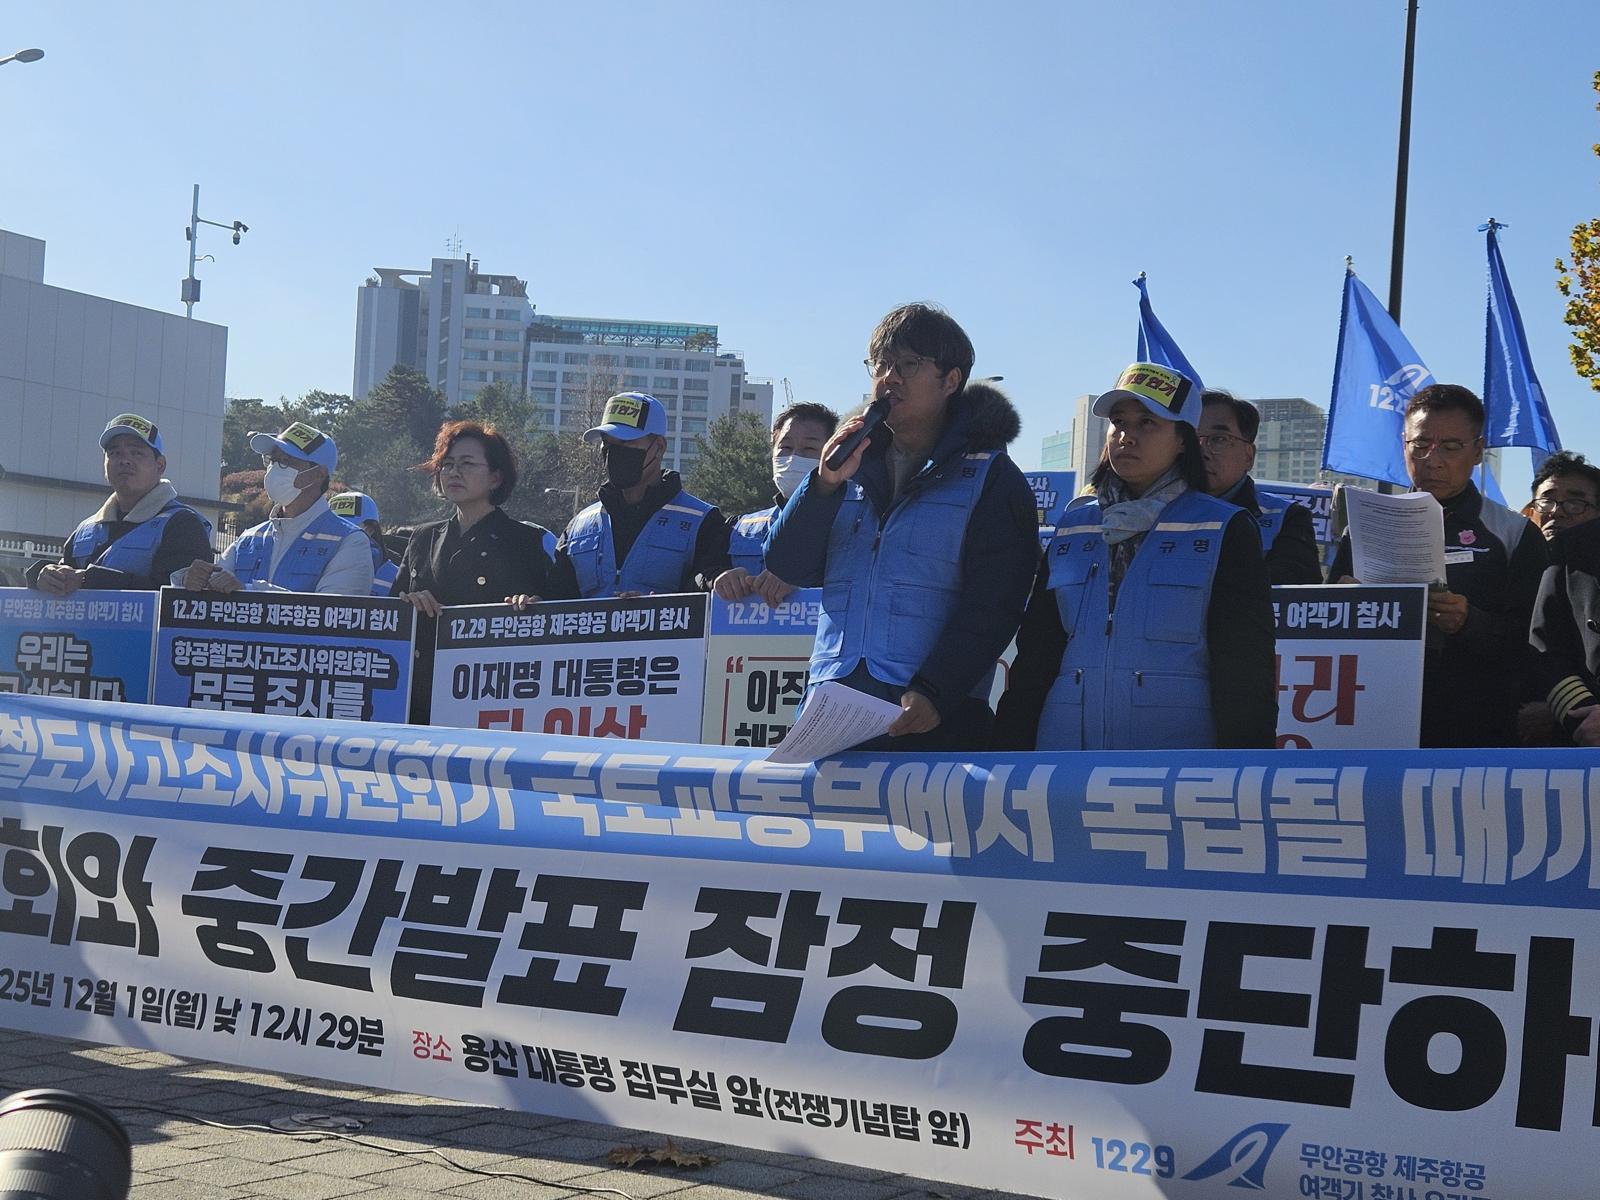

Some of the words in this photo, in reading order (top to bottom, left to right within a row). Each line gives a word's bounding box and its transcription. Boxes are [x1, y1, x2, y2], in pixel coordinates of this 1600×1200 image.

[4, 598, 43, 619] 무안공항
[45, 599, 86, 621] 제주항공
[88, 600, 119, 622] 여객기
[121, 600, 144, 623] 참사
[173, 599, 207, 620] 12.29
[210, 601, 263, 625] 무안공항
[266, 604, 321, 628] 제주항공
[324, 606, 367, 630] 여객기
[370, 609, 399, 632] 참사
[450, 618, 486, 640] 12.29
[489, 614, 546, 639] 무안공항
[549, 611, 607, 636] 제주항공
[610, 608, 655, 633] 여객기
[659, 607, 691, 631] 참사
[726, 602, 769, 625] 12.29
[1286, 601, 1350, 629] 여객기
[1356, 601, 1401, 629] 참사
[17, 635, 89, 674] 우리는
[174, 640, 391, 679] 항공철도사고조사위원회는
[190, 671, 255, 713] 모든
[263, 676, 365, 721] 조사를
[452, 660, 542, 700] 이재명
[551, 655, 681, 698] 대통령은
[0, 712, 517, 831] 철도사고조사위원회가
[530, 752, 1055, 863] 국토교통부에서
[1081, 765, 1369, 879] 독립될
[0, 817, 160, 958] 회와
[181, 846, 650, 1017] 중간발표
[672, 887, 977, 1060] 잠정
[1022, 910, 1600, 1132] 중단하
[0, 968, 55, 1009] 25년
[63, 976, 119, 1018] 12월
[126, 984, 209, 1032] 1일(월)
[212, 995, 243, 1035] 낮
[250, 1001, 313, 1047] 12시
[315, 1011, 386, 1057] 29분
[412, 1030, 453, 1063] 장소
[461, 1034, 519, 1079] 용산
[521, 1044, 617, 1093] 대통령
[619, 1059, 722, 1112] 집무실
[925, 1108, 972, 1150] 앞)
[1014, 1118, 1076, 1161] 주최
[1091, 1136, 1176, 1180] 1229
[1299, 1142, 1388, 1178] 무안공항
[1392, 1154, 1487, 1191] 제주항공
[1299, 1173, 1364, 1200] 여객기
